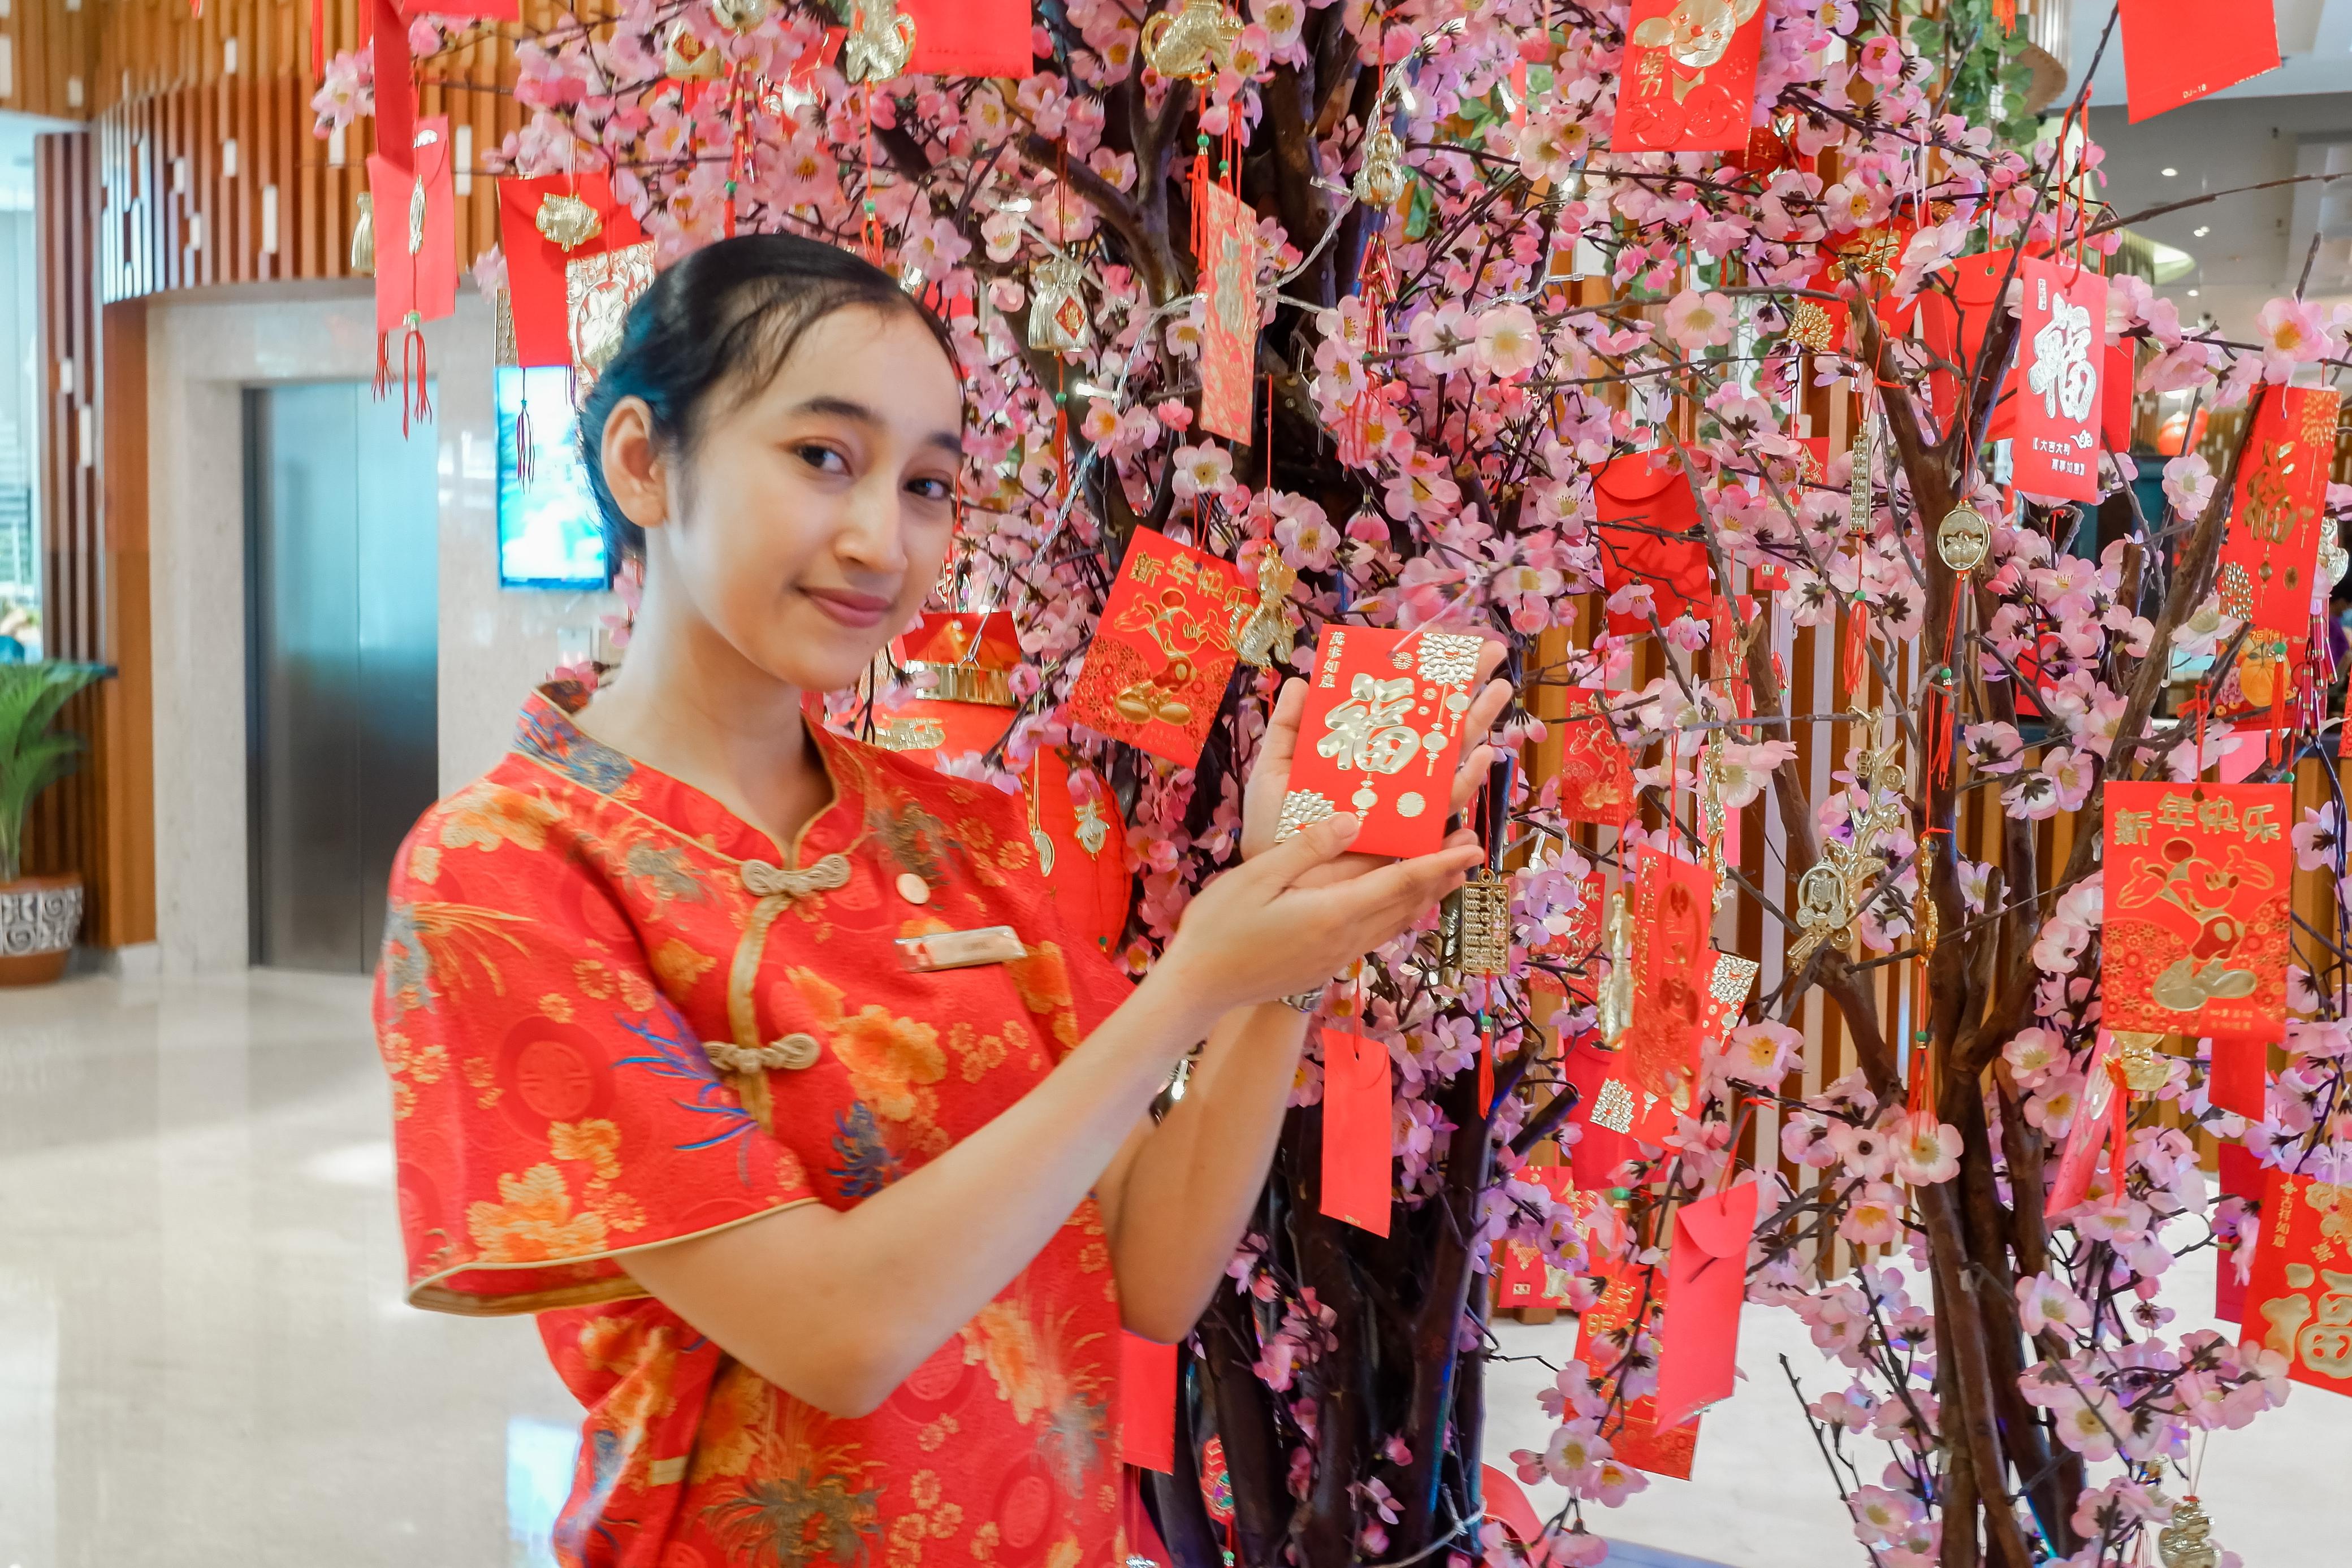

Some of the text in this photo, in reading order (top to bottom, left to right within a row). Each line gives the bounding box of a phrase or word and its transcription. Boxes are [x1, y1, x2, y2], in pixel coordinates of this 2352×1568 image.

[2027, 292, 2097, 423] 福
[2242, 438, 2297, 545] 福
[1318, 631, 1347, 688] 萬事如意
[1316, 672, 1420, 776] 福
[2114, 791, 2281, 847] 新年快乐
[2259, 1263, 2352, 1380] 福
